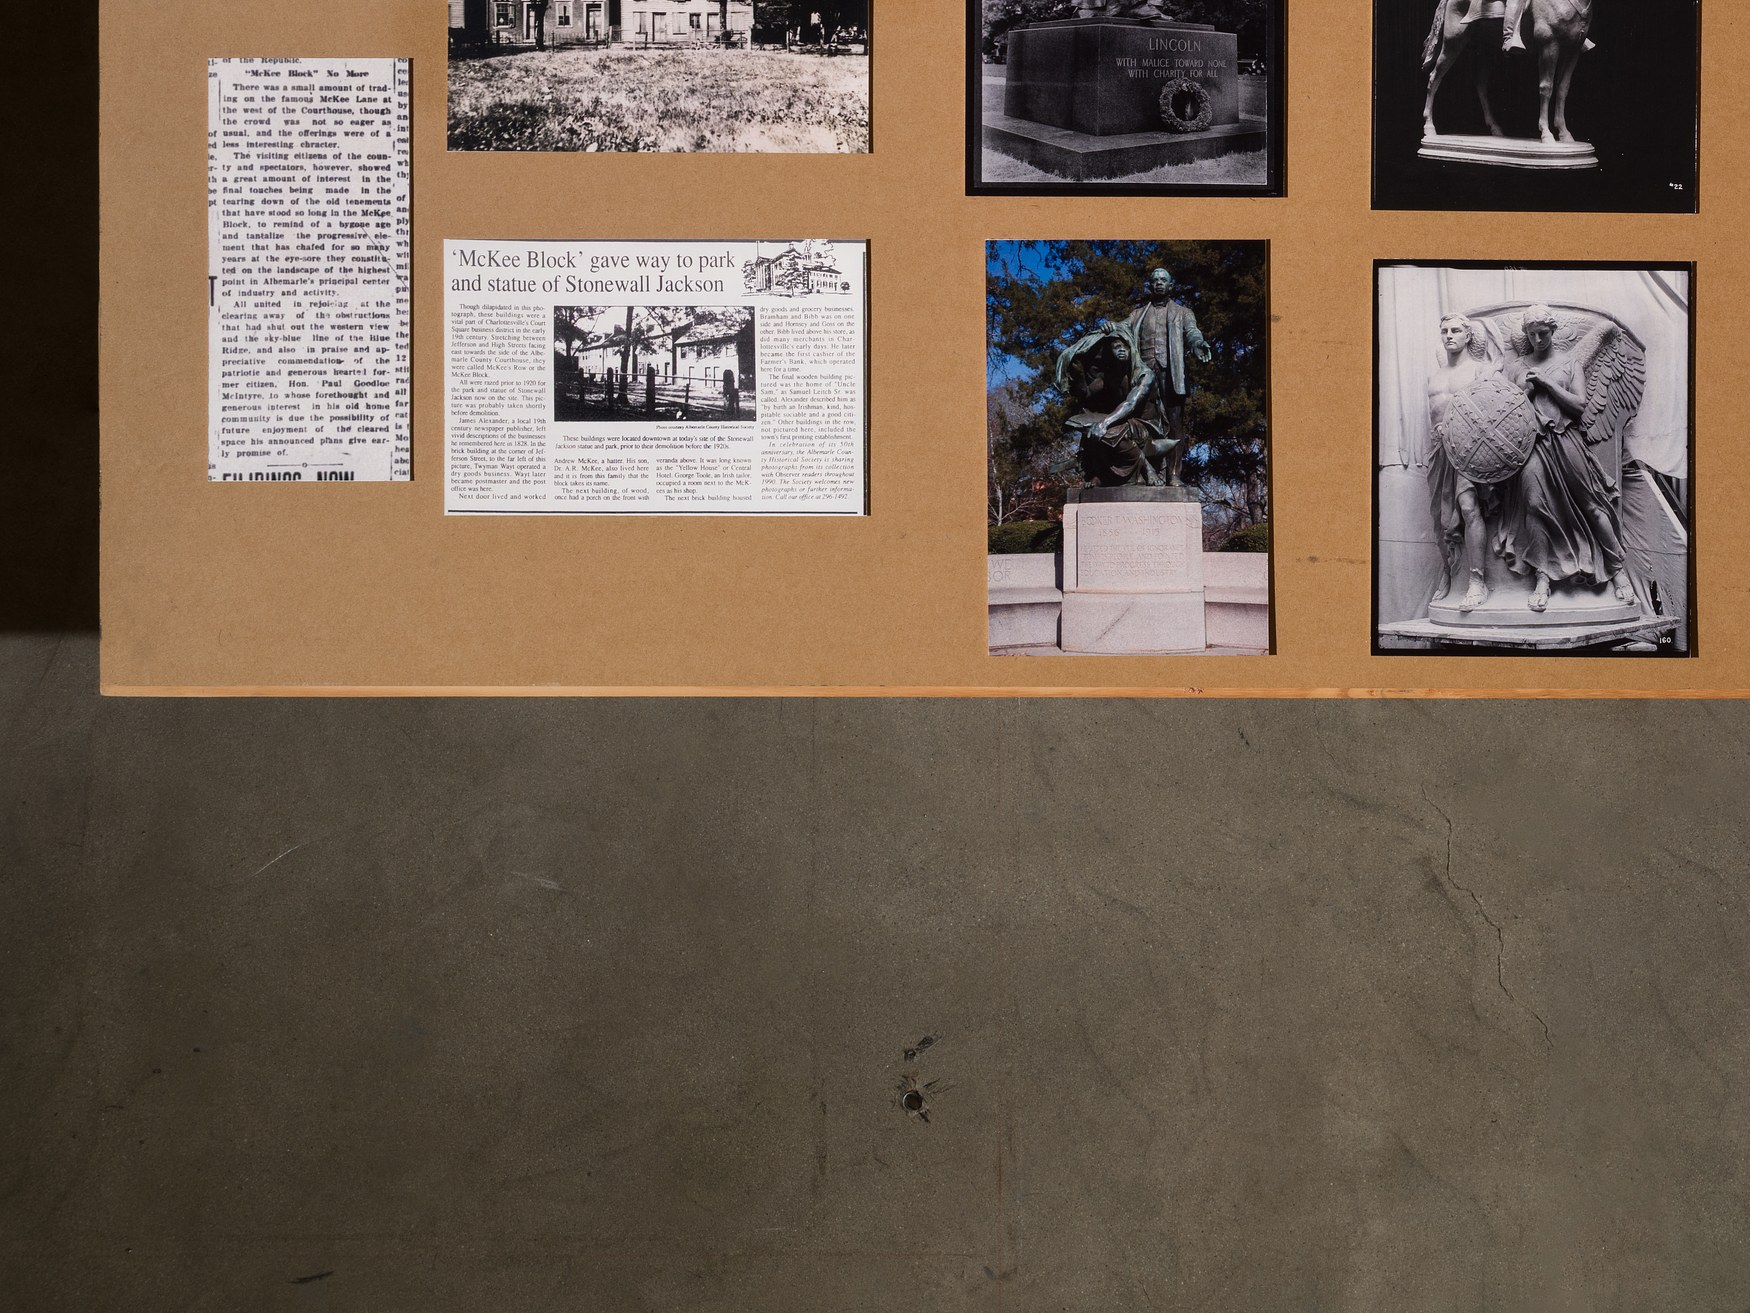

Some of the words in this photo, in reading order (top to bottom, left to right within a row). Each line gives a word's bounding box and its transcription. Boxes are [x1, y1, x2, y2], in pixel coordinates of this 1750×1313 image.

[1149, 38, 1201, 52] LINCOLN
[1116, 58, 1137, 67] WITH
[1142, 59, 1169, 67] MALICE
[1175, 58, 1204, 68] TOWARD
[1207, 58, 1227, 69] NONE
[245, 69, 281, 77] “McKee
[346, 70, 370, 78] More
[1128, 69, 1148, 78] WITH
[1154, 69, 1186, 79] CHARITY
[1190, 69, 1203, 78] FOR
[1206, 69, 1218, 79] ALL
[232, 83, 260, 91] There
[291, 84, 315, 92] small
[356, 84, 366, 92] of
[223, 140, 240, 148] less
[246, 141, 294, 150] interesting
[452, 249, 521, 268] ‘McKee
[527, 251, 583, 269] Block’
[590, 256, 630, 273] gave
[636, 256, 671, 273] way
[677, 254, 693, 268] to
[699, 251, 735, 273] park
[451, 274, 482, 292] and
[488, 277, 537, 293] statue
[542, 275, 561, 293] of
[566, 274, 650, 293] Stonewall
[656, 274, 724, 293] Jackson
[238, 289, 275, 298] industry
[281, 289, 297, 297] and
